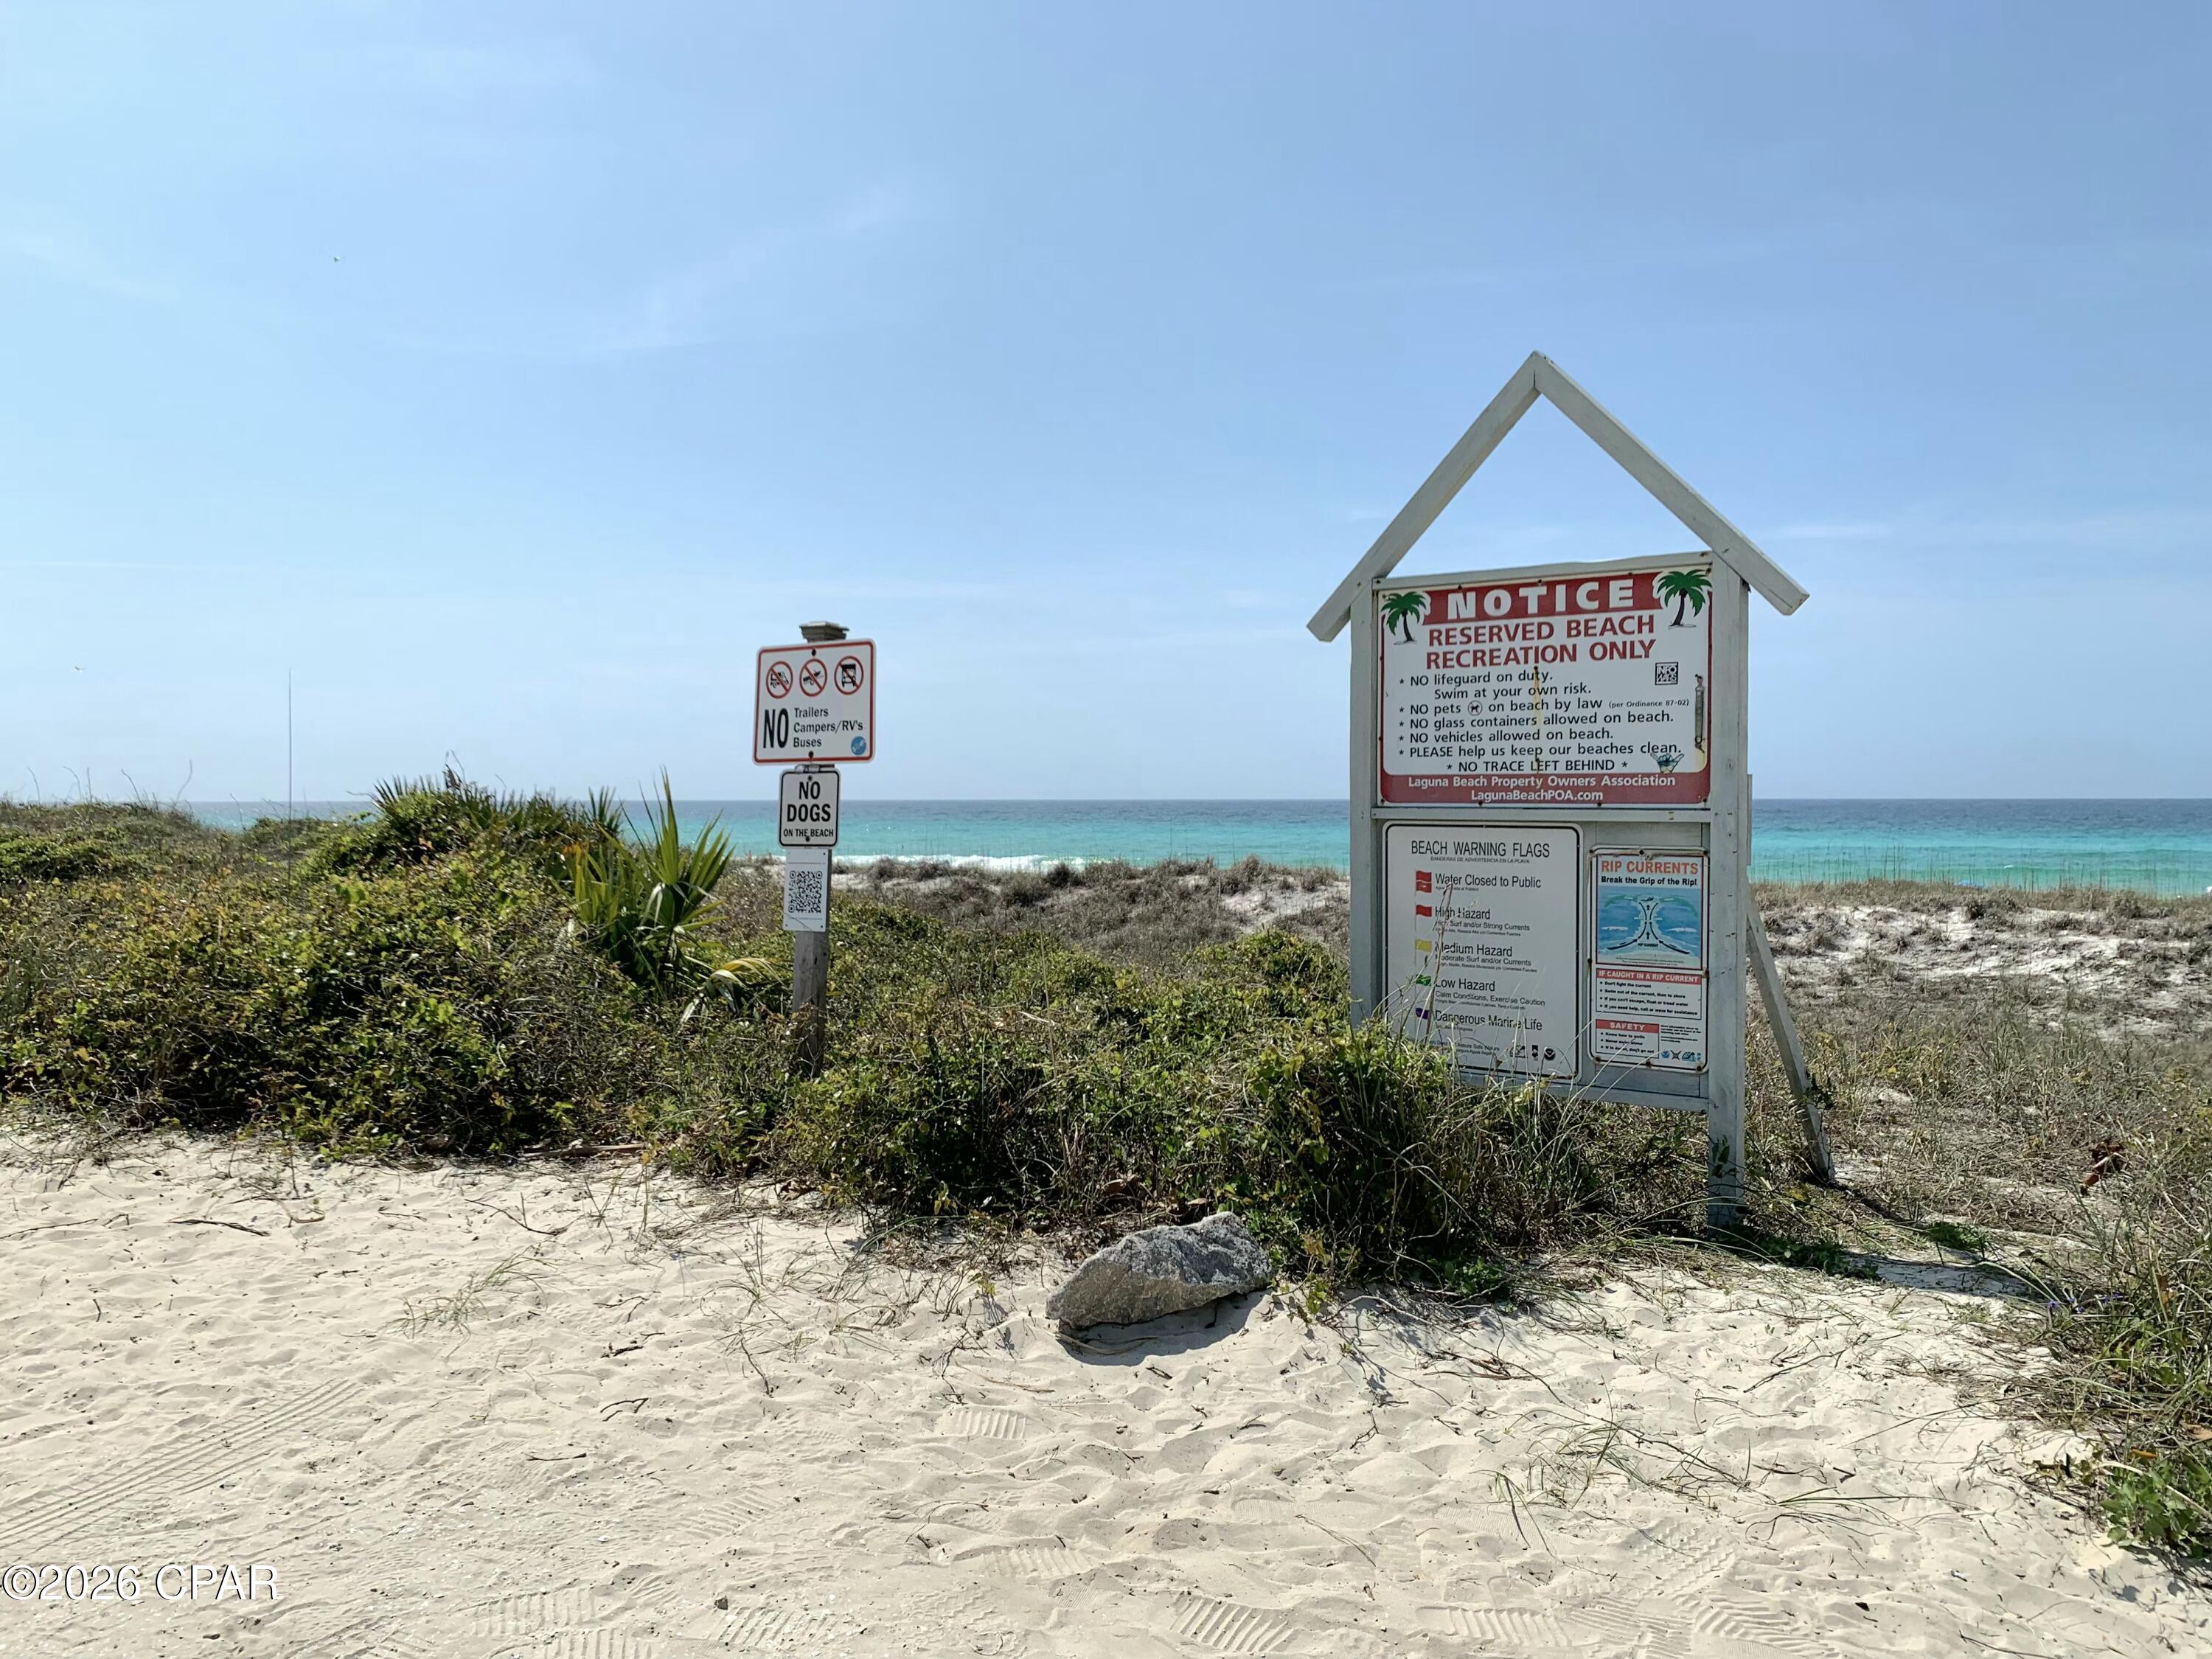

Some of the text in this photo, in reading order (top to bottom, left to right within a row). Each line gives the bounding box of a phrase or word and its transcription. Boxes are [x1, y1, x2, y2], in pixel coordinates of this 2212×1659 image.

[1447, 578, 1634, 620] NOTICE
[1428, 614, 1655, 647] RESERVED BEACH
[1426, 639, 1657, 670] RECREATION ONLY
[1410, 669, 1553, 687] NO lifeguard on duty.
[1434, 682, 1591, 700] Swim at your own risk.
[793, 706, 829, 718] Trailers
[1410, 703, 1429, 715] NO
[1434, 703, 1461, 717] pets
[1488, 703, 1504, 712] on
[1510, 698, 1549, 712] beach
[1554, 698, 1571, 712] by
[1577, 697, 1603, 709] law
[1609, 701, 1624, 709] (per
[1666, 698, 1690, 707] 87-02)
[793, 720, 863, 734] Campers/RV's
[1410, 709, 1674, 731] NO glass containers allowed on beach.
[762, 708, 789, 748] NO
[1410, 727, 1614, 743] NO vehicles allowed on beach.
[793, 737, 822, 748] Buses
[1410, 741, 1682, 759] PLEASE help us keep our beaches clean.
[1458, 759, 1615, 773] NO TRACE LEFT BEHIND
[1408, 774, 1675, 790] Laguna Beach Property Owners Association
[799, 781, 821, 800] NO
[1471, 789, 1604, 803] LagunaBeachPOA.com
[786, 803, 831, 822] DOGS
[783, 828, 834, 837] ON THE BEACH
[1411, 840, 1550, 858] BEACH WARNING FLAGS
[1601, 860, 1699, 875] RIP CURRENTS
[1435, 873, 1542, 888] Water Closed to Public
[1601, 875, 1623, 883] Break
[1625, 876, 1638, 884] the
[1639, 877, 1655, 886] Grip
[1682, 878, 1697, 888] Rip!
[1435, 905, 1491, 920] High Hazard
[1484, 922, 1503, 931] Strong
[1504, 923, 1531, 931] Currents
[1435, 942, 1512, 957] Medium Hazard
[1503, 958, 1531, 967] Currents
[1458, 978, 1495, 992] Hazard
[1665, 975, 1699, 983] CURRENT
[1435, 990, 1451, 998] Calm
[1453, 992, 1488, 1001] Conditions,
[1490, 995, 1518, 1004] Exercse
[1520, 997, 1545, 1006] Caution
[1435, 1010, 1486, 1026] Dangerous
[1489, 1015, 1522, 1029] Marine
[1524, 1018, 1543, 1031] Life
[1610, 1022, 1645, 1032] SAFETY
